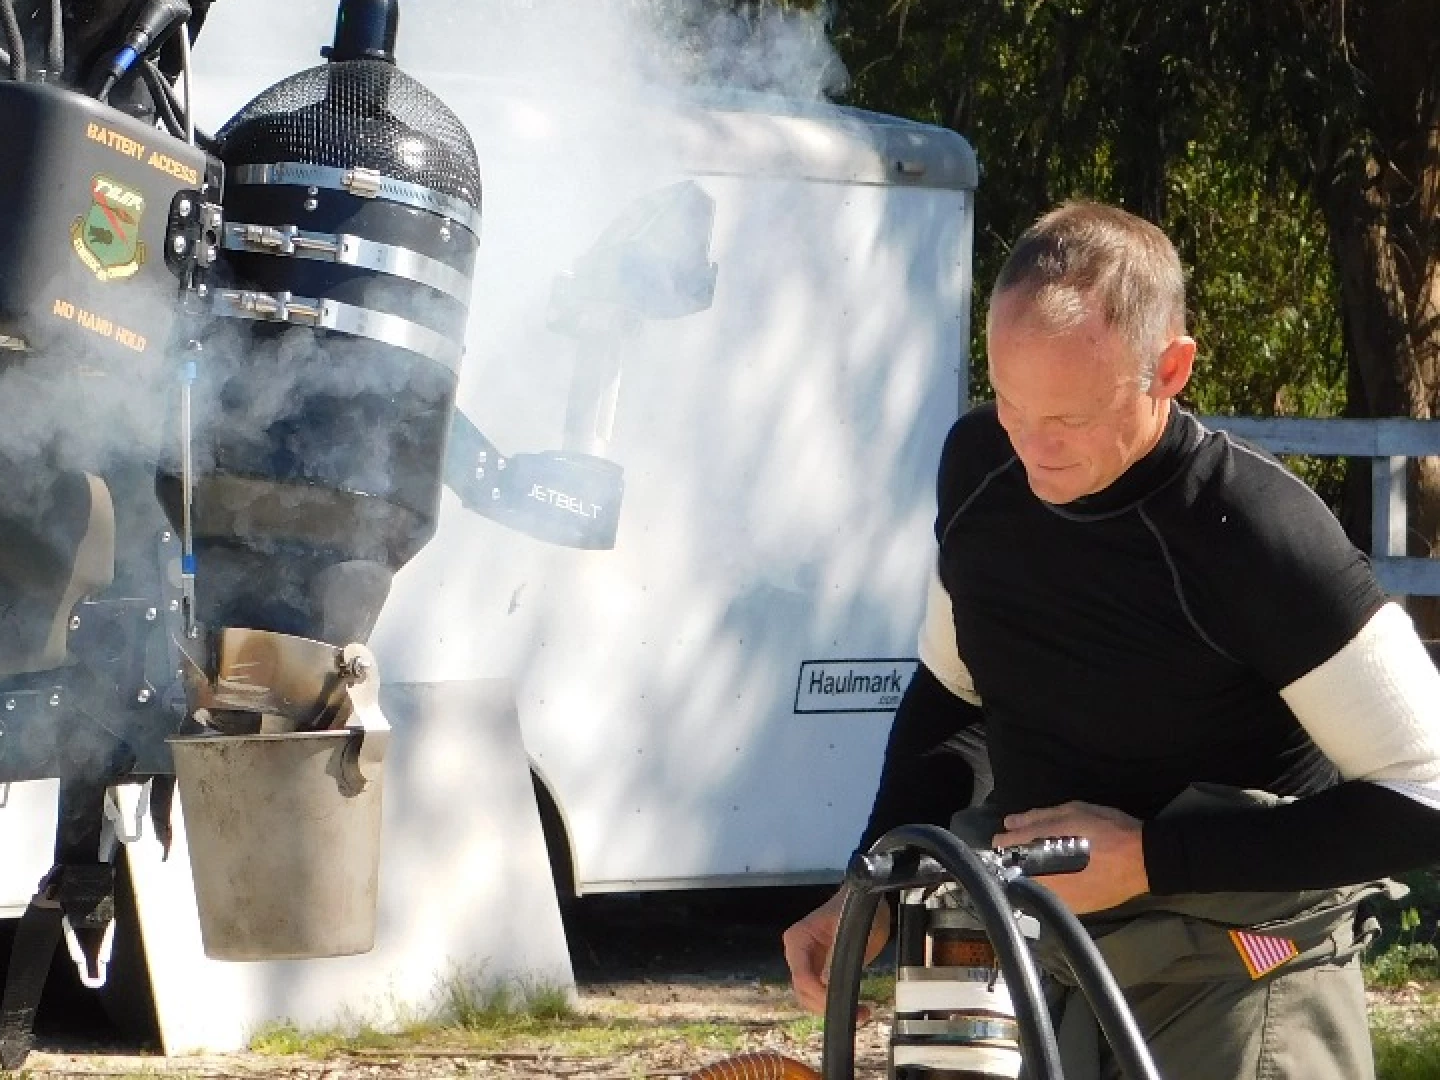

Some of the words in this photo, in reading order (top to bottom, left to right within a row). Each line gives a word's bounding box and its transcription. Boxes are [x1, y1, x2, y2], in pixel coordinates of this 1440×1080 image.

[86, 121, 145, 161] BATTERY
[147, 151, 198, 185] ACCESS
[53, 299, 75, 319] NO
[115, 325, 147, 353] HOLD
[528, 483, 602, 519] JETBELT
[808, 668, 902, 695] Haulmark
